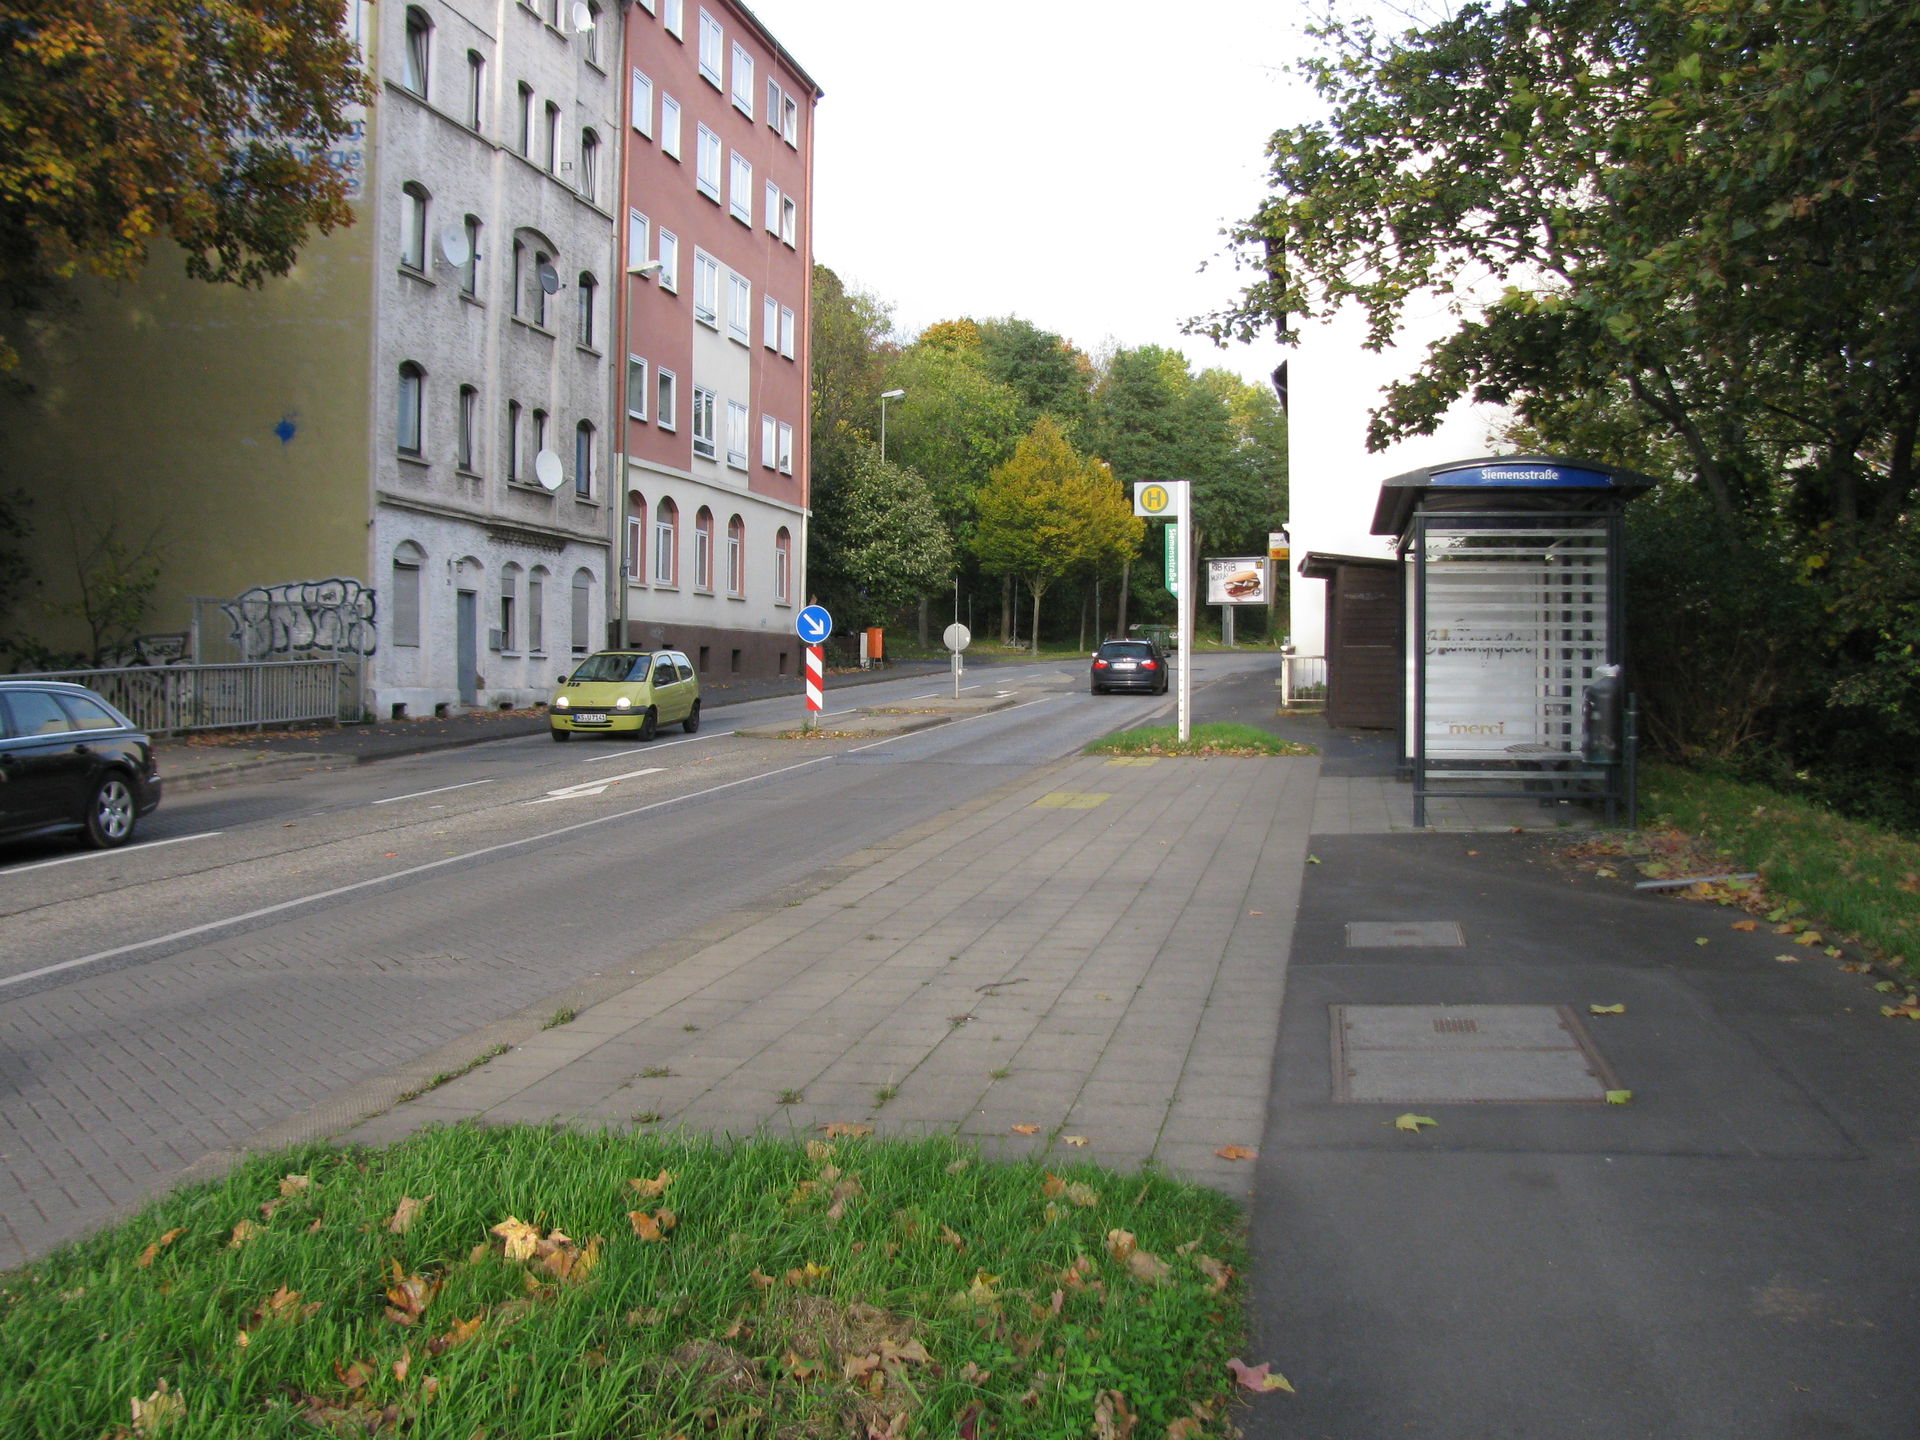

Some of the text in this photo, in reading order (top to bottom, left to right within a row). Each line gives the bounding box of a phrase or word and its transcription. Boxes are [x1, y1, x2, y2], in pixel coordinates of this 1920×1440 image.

[1481, 469, 1559, 480] Siemensstraße
[1147, 491, 1162, 507] H
[1168, 528, 1178, 582] Siemensstraße
[1448, 721, 1505, 736] merci
